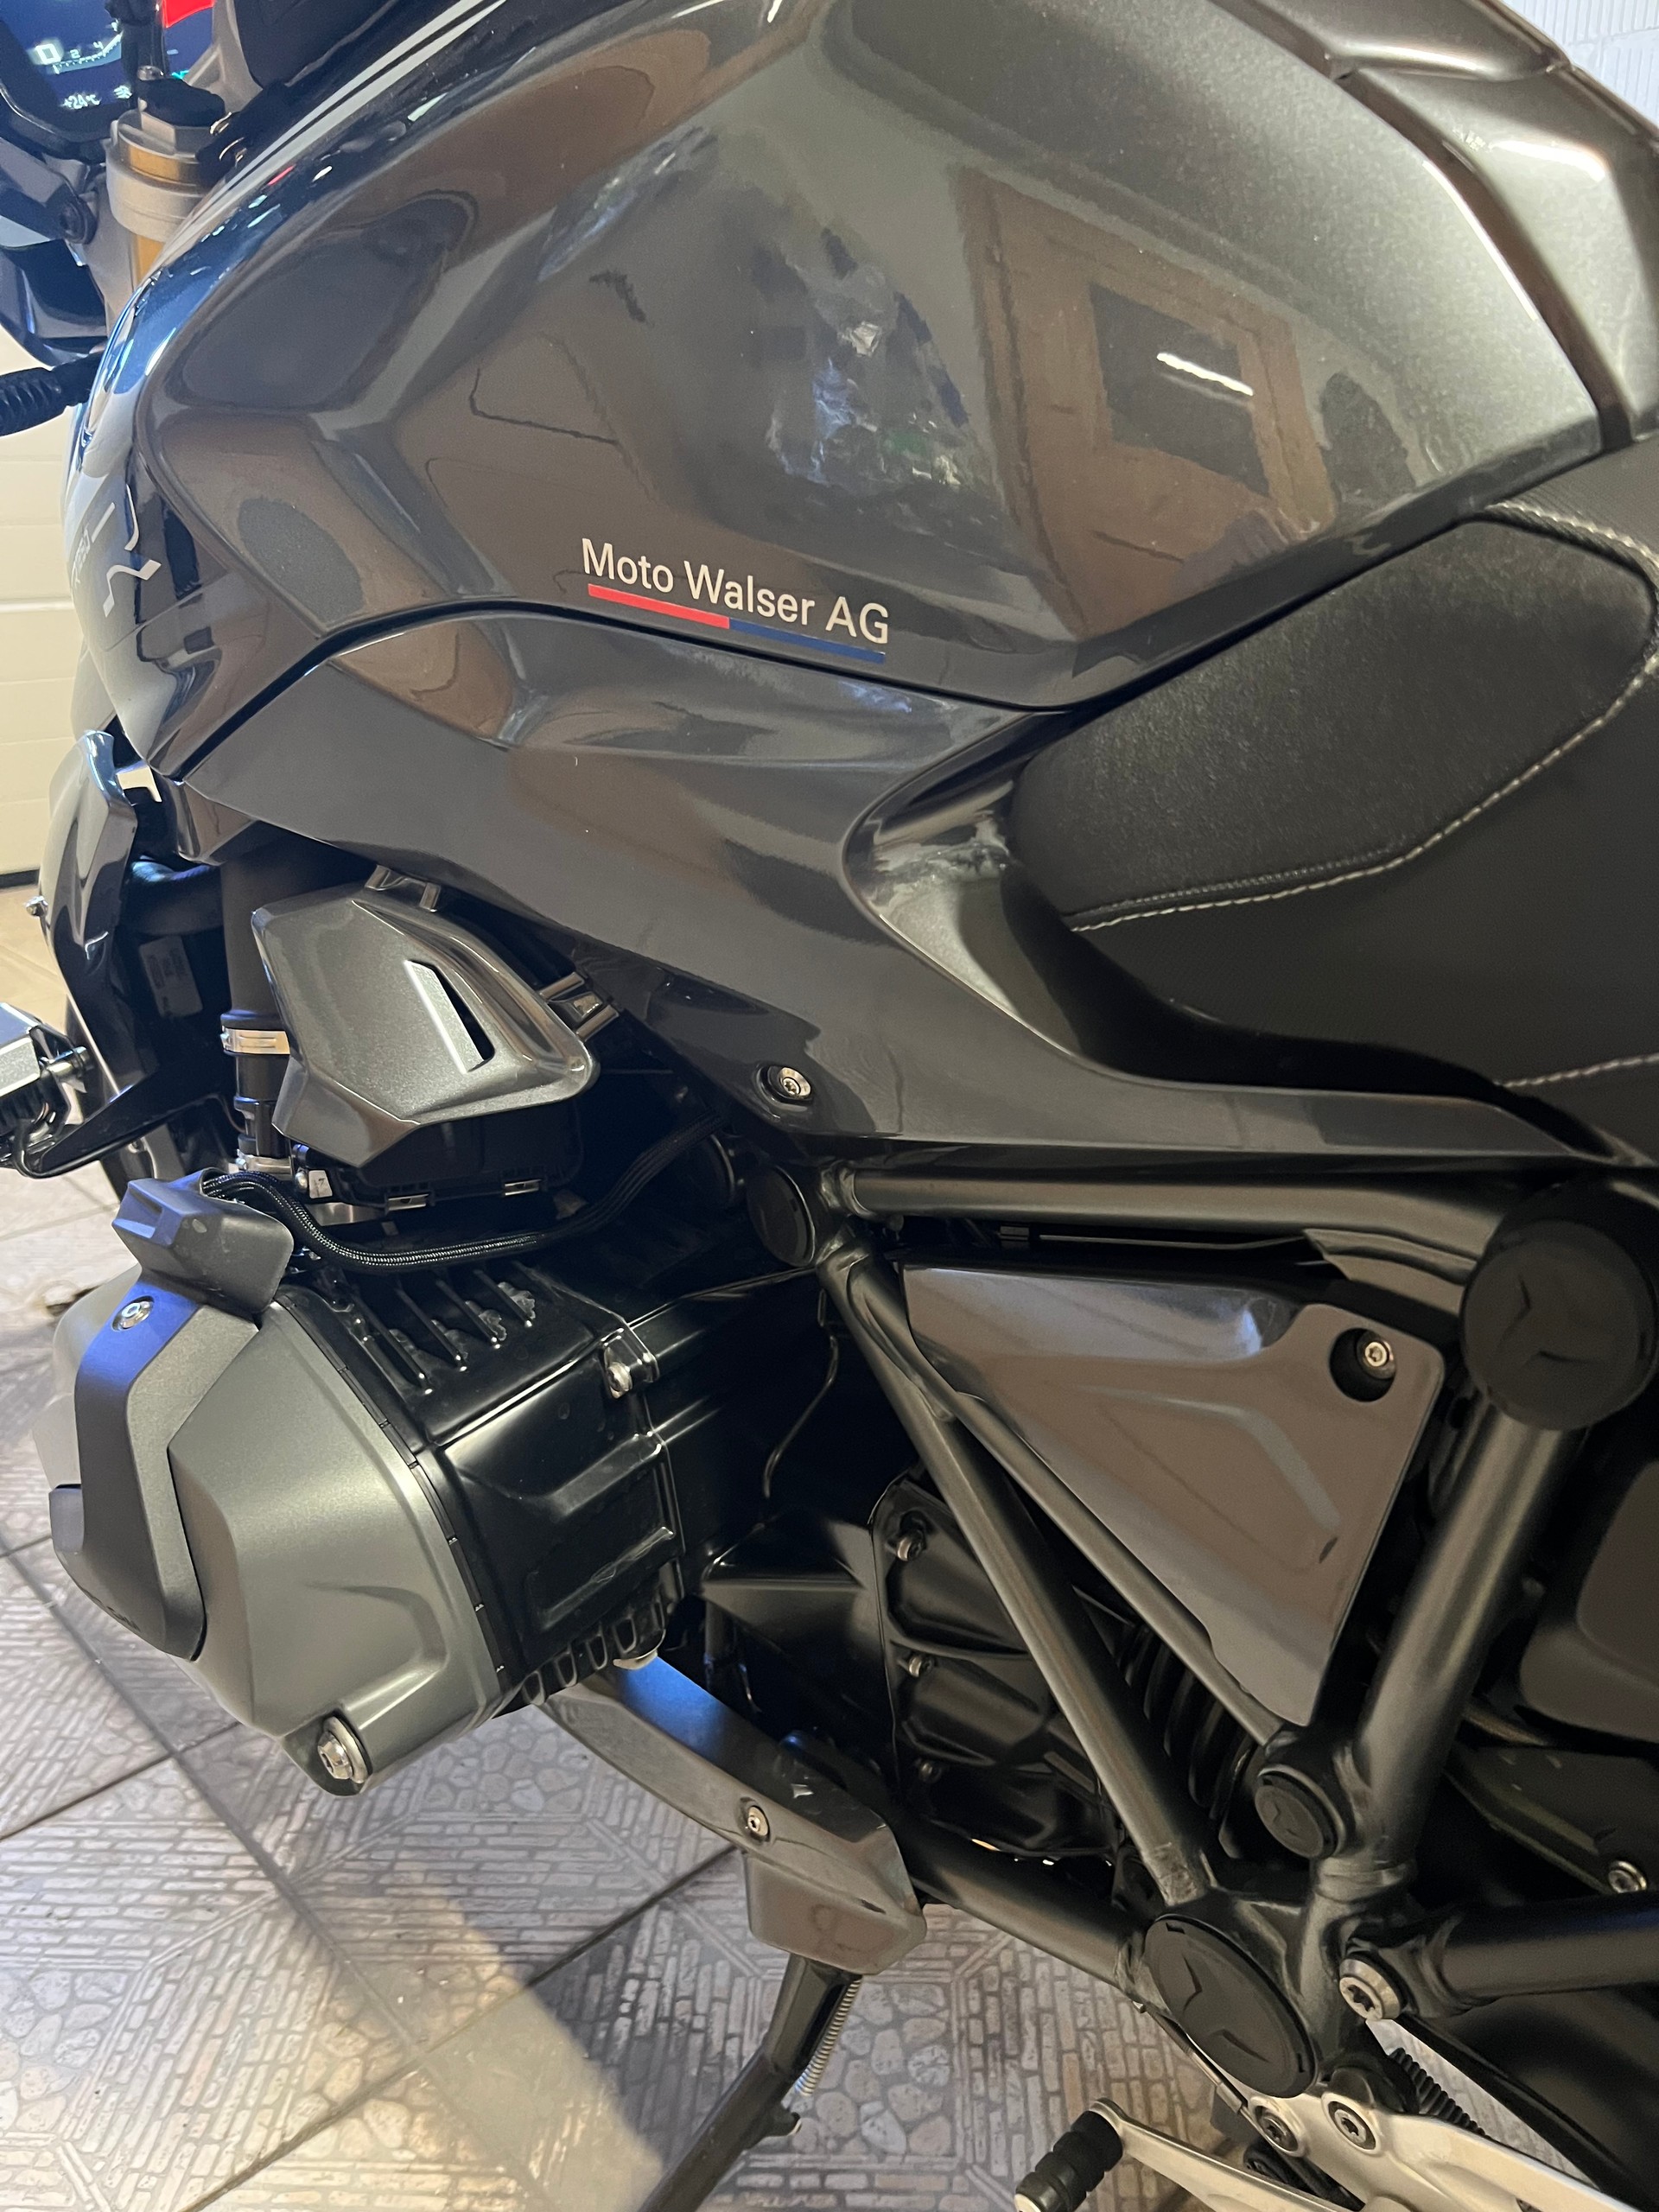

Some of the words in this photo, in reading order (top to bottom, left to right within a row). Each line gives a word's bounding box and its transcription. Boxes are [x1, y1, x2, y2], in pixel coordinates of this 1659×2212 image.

[582, 537, 674, 593] Moto
[683, 560, 816, 626] Walser
[824, 595, 889, 644] AG
